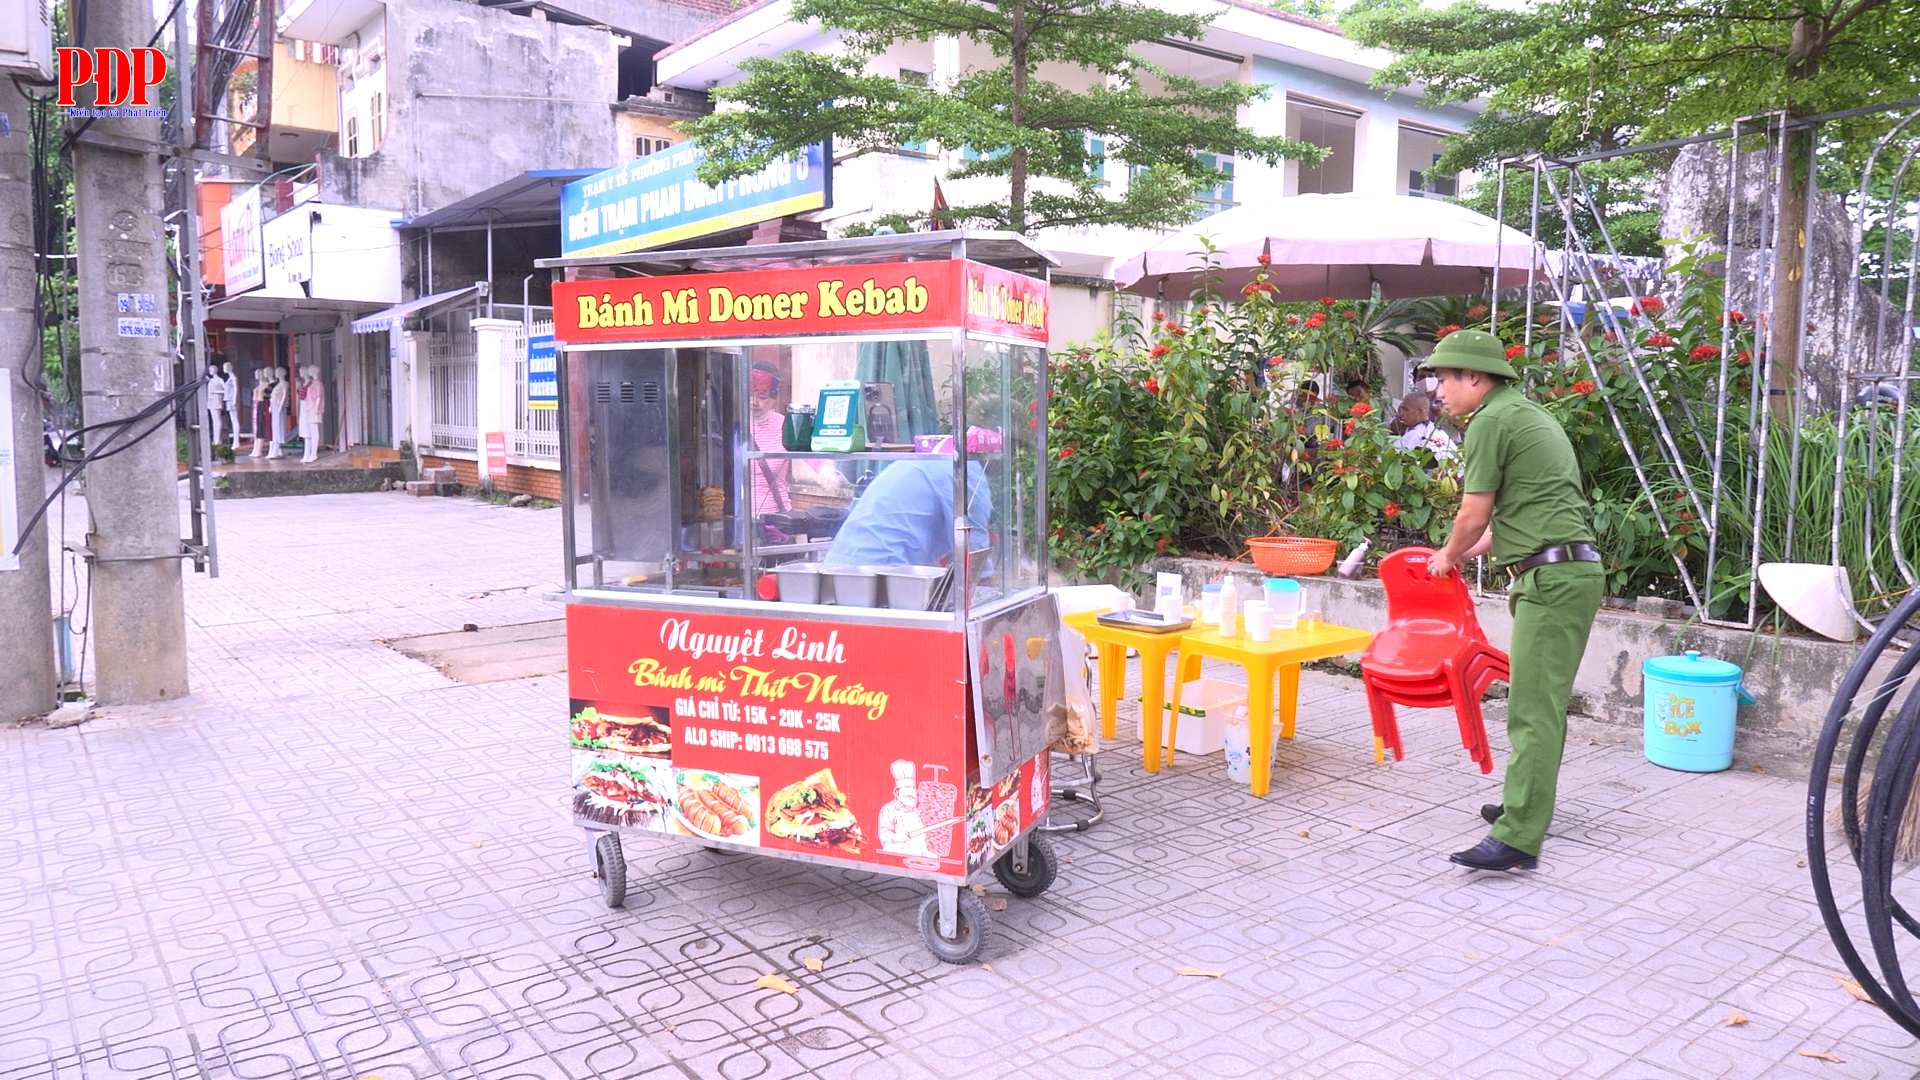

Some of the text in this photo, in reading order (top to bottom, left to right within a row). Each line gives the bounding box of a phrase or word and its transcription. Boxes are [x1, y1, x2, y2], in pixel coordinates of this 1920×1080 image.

[607, 176, 615, 190] Y
[568, 200, 599, 241] ĐIỂM
[601, 196, 638, 235] TRẠM
[640, 183, 681, 223] PHAN
[577, 276, 928, 328] Bánh Mì Doner Kebab
[660, 618, 847, 664] Nguyệt Linh
[628, 657, 889, 720] Bánh mì Thịt Nướng
[675, 695, 697, 718] GIÁ
[698, 695, 719, 720] CHỈ
[721, 699, 742, 722] TỪ:
[743, 704, 768, 725] 15K
[779, 708, 804, 729] 20K
[815, 712, 841, 733] 25K
[684, 726, 829, 761] ALO SHIP: 0913 698 575
